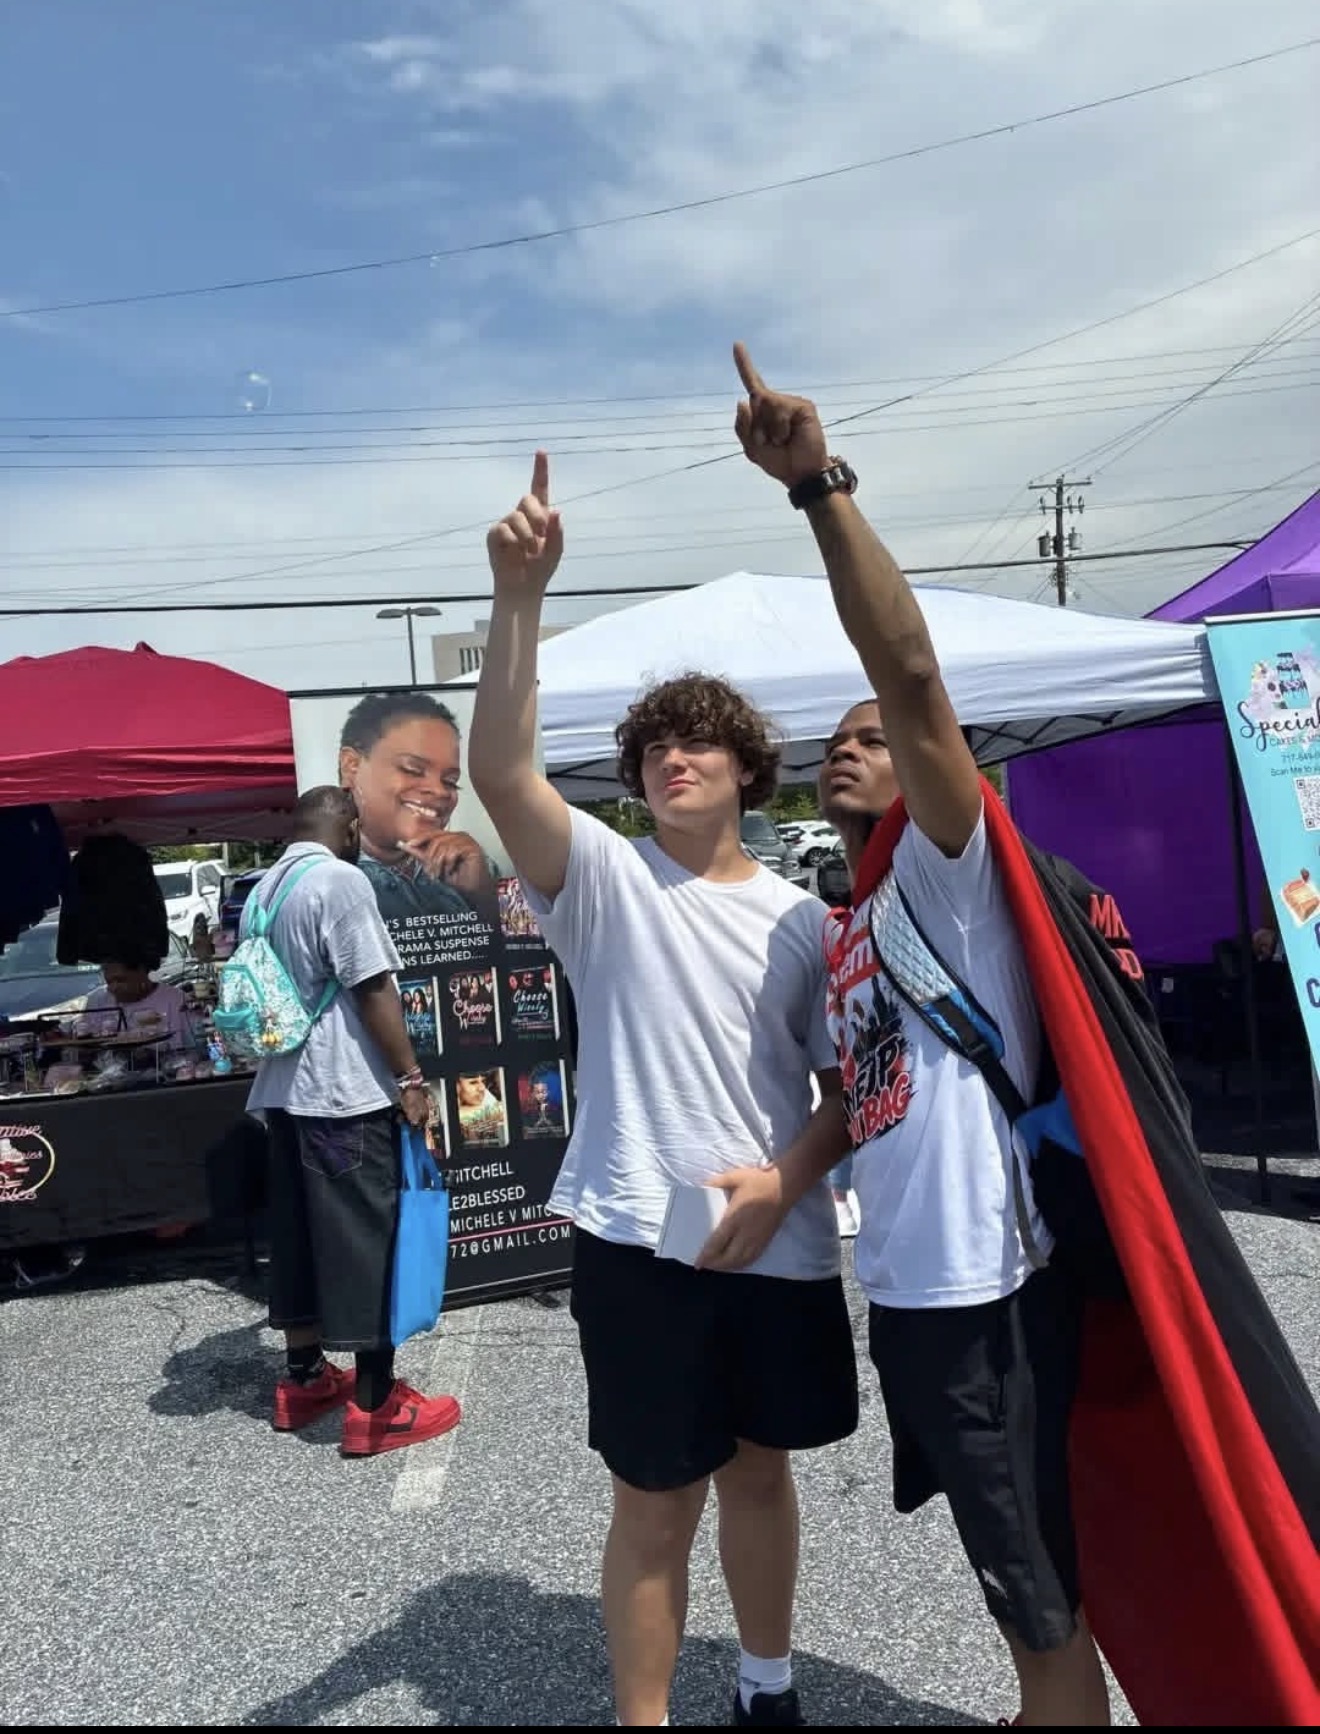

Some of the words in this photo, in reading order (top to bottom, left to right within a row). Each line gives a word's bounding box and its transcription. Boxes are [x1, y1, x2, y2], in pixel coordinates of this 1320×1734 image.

[405, 911, 478, 928] BESTSELLING
[390, 928, 425, 942] CHELE
[440, 923, 495, 937] MITCHELL
[397, 942, 432, 954] RAMA
[434, 935, 490, 951] SUSPENSE
[401, 955, 418, 967] NS
[862, 1070, 911, 1140] BAG
[449, 1185, 526, 1212] E2BLESSED
[450, 1210, 505, 1234] MICHELE
[509, 1208, 517, 1224] V
[522, 1203, 555, 1221] MITC
[450, 1224, 571, 1260] 72@GMAIL.COM
